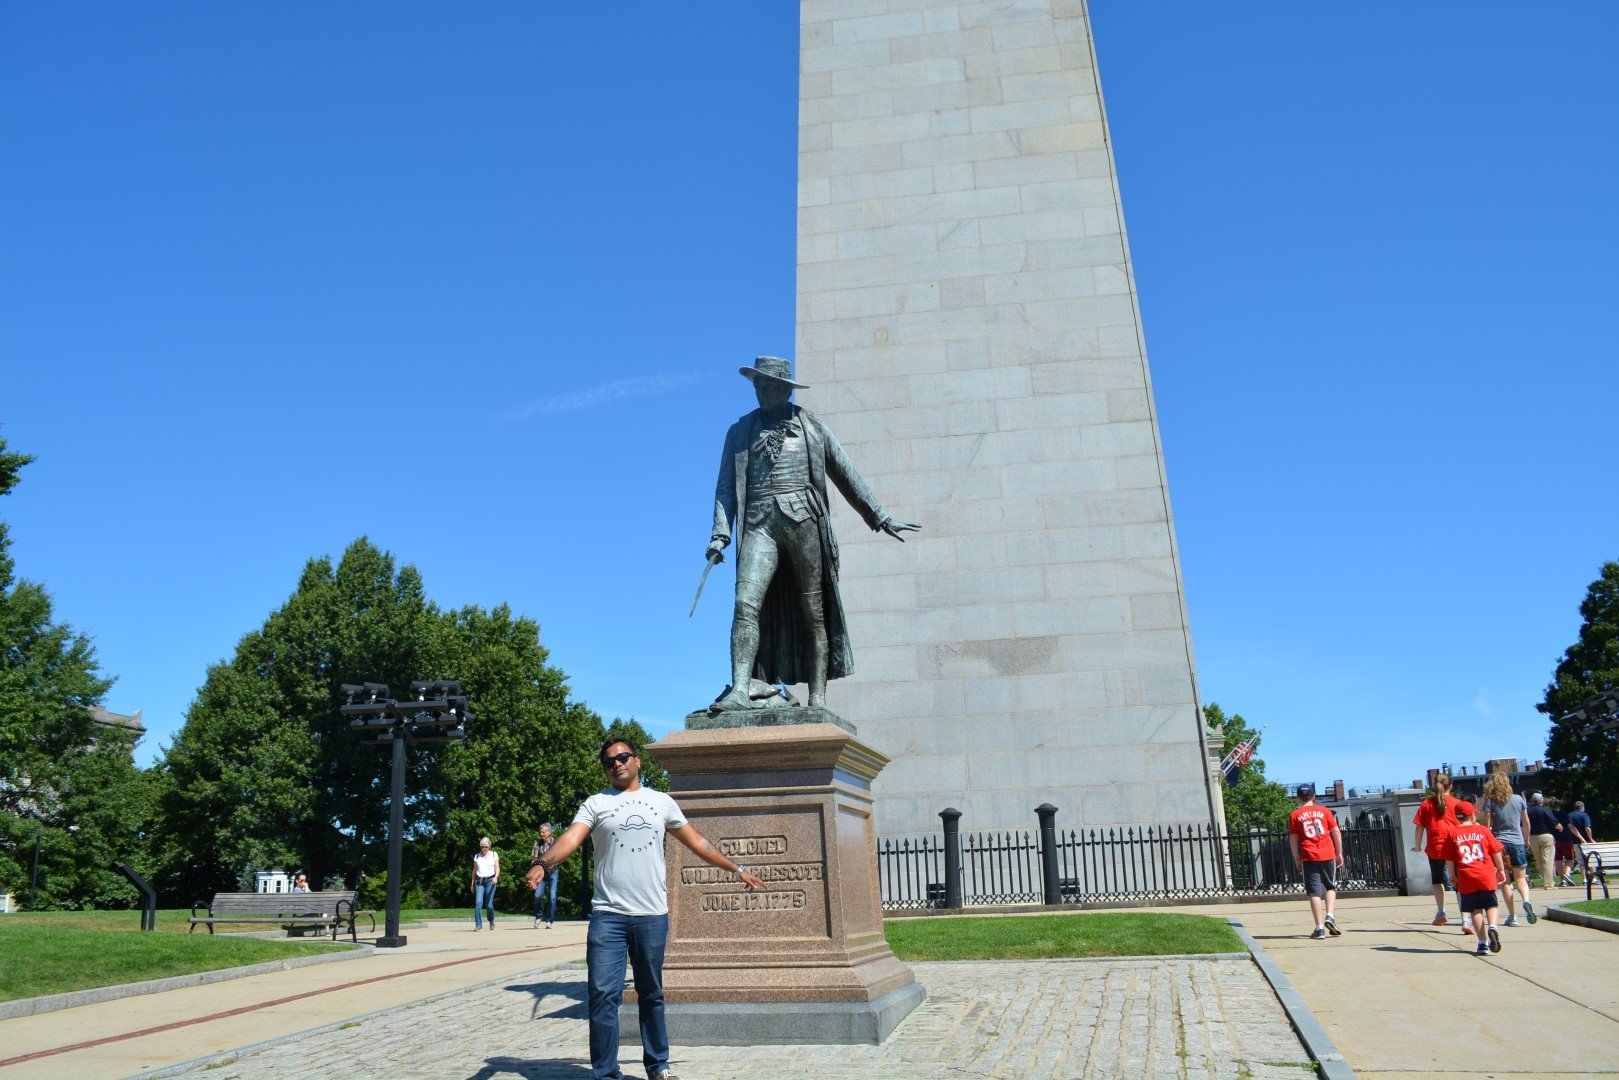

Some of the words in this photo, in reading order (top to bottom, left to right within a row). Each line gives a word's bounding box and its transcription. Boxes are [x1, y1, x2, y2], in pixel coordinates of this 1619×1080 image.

[719, 837, 785, 855] COLONEL
[1459, 843, 1484, 864] 34
[750, 864, 822, 882] PRESCOTT
[702, 894, 740, 911] JUNE
